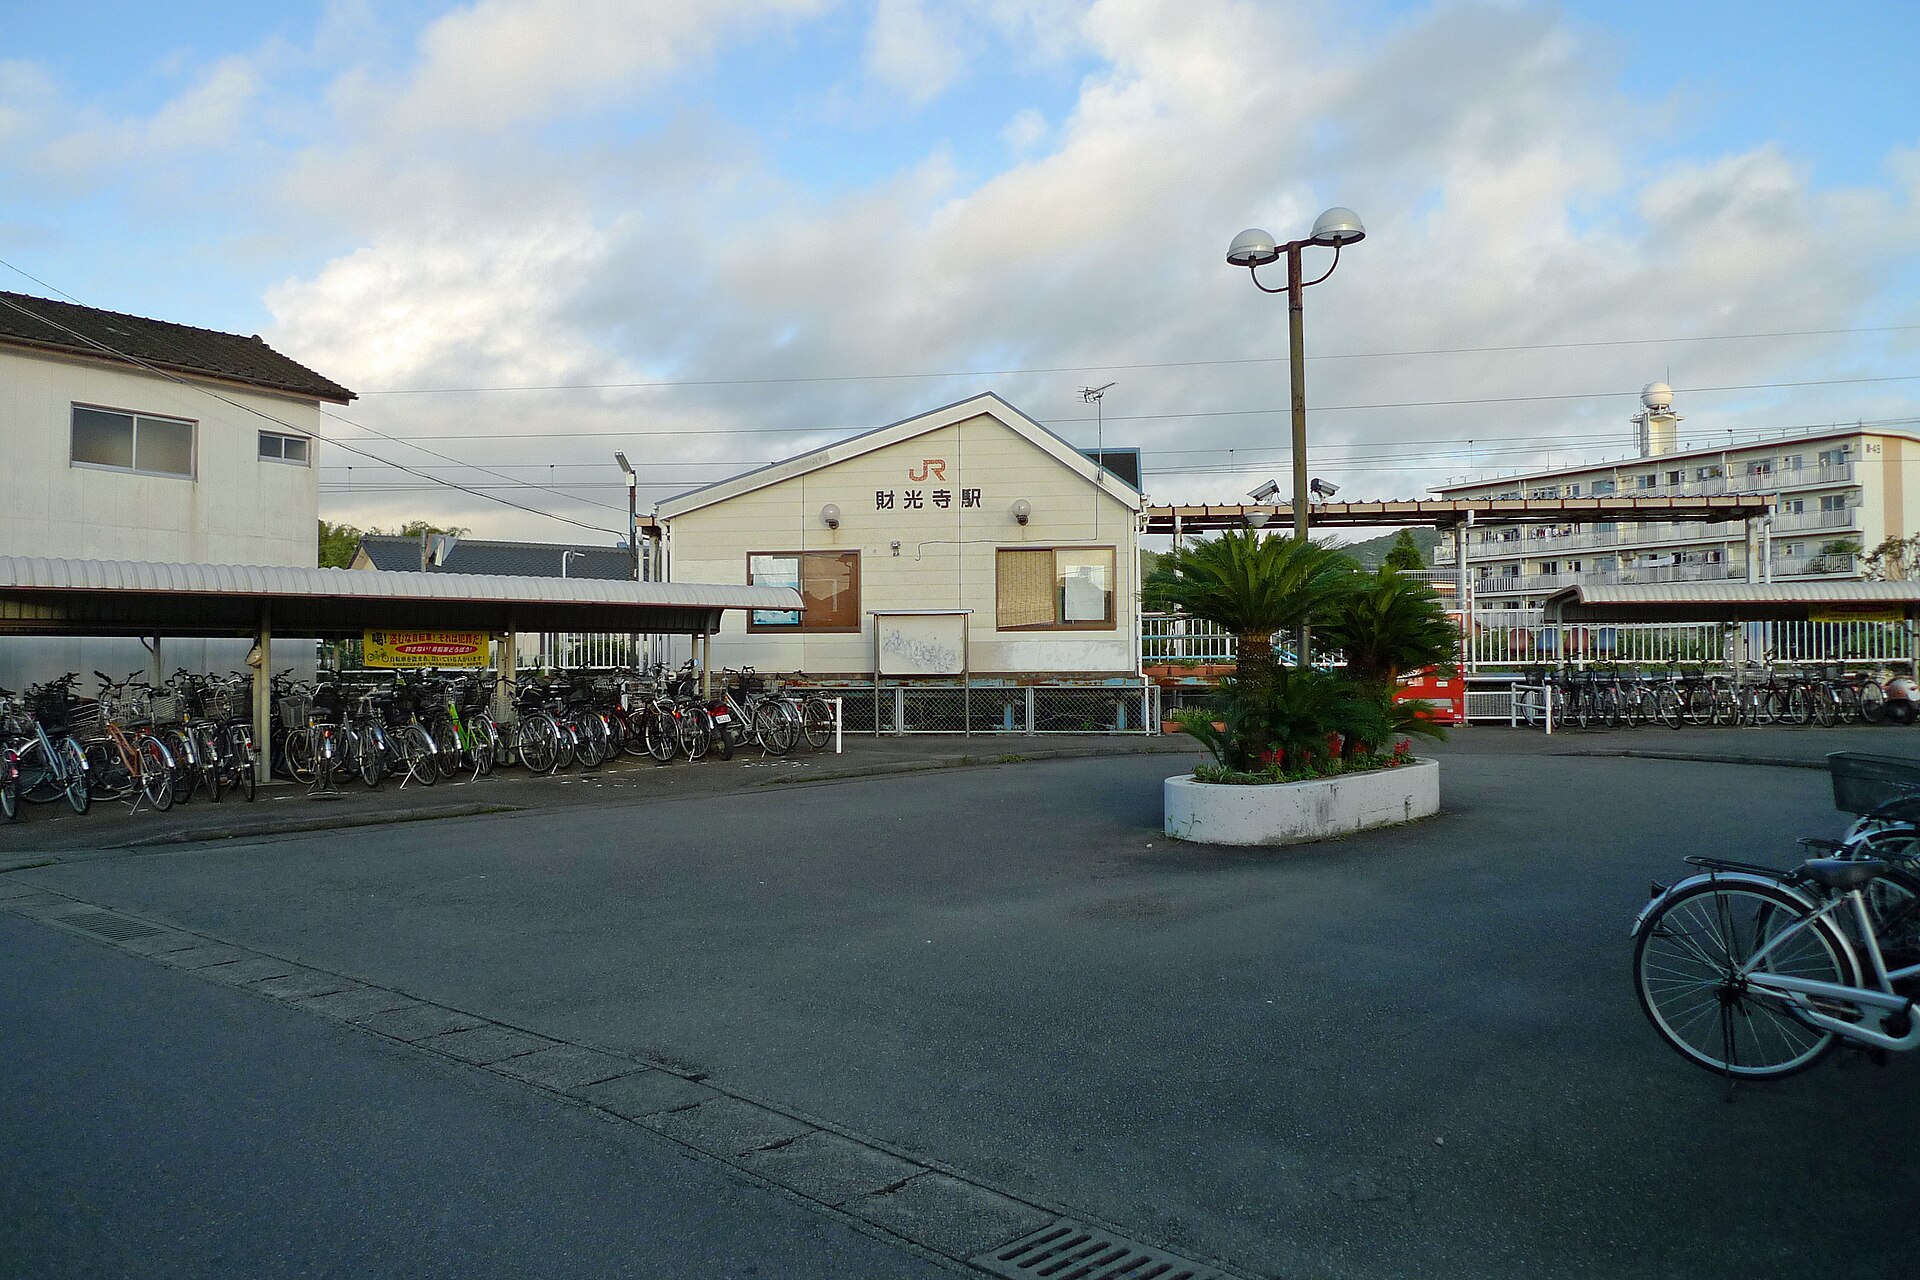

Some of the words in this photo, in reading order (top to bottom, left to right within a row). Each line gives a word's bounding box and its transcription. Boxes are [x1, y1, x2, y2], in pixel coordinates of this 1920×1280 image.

[909, 459, 946, 481] JR
[876, 488, 981, 510] 財光寺駅
